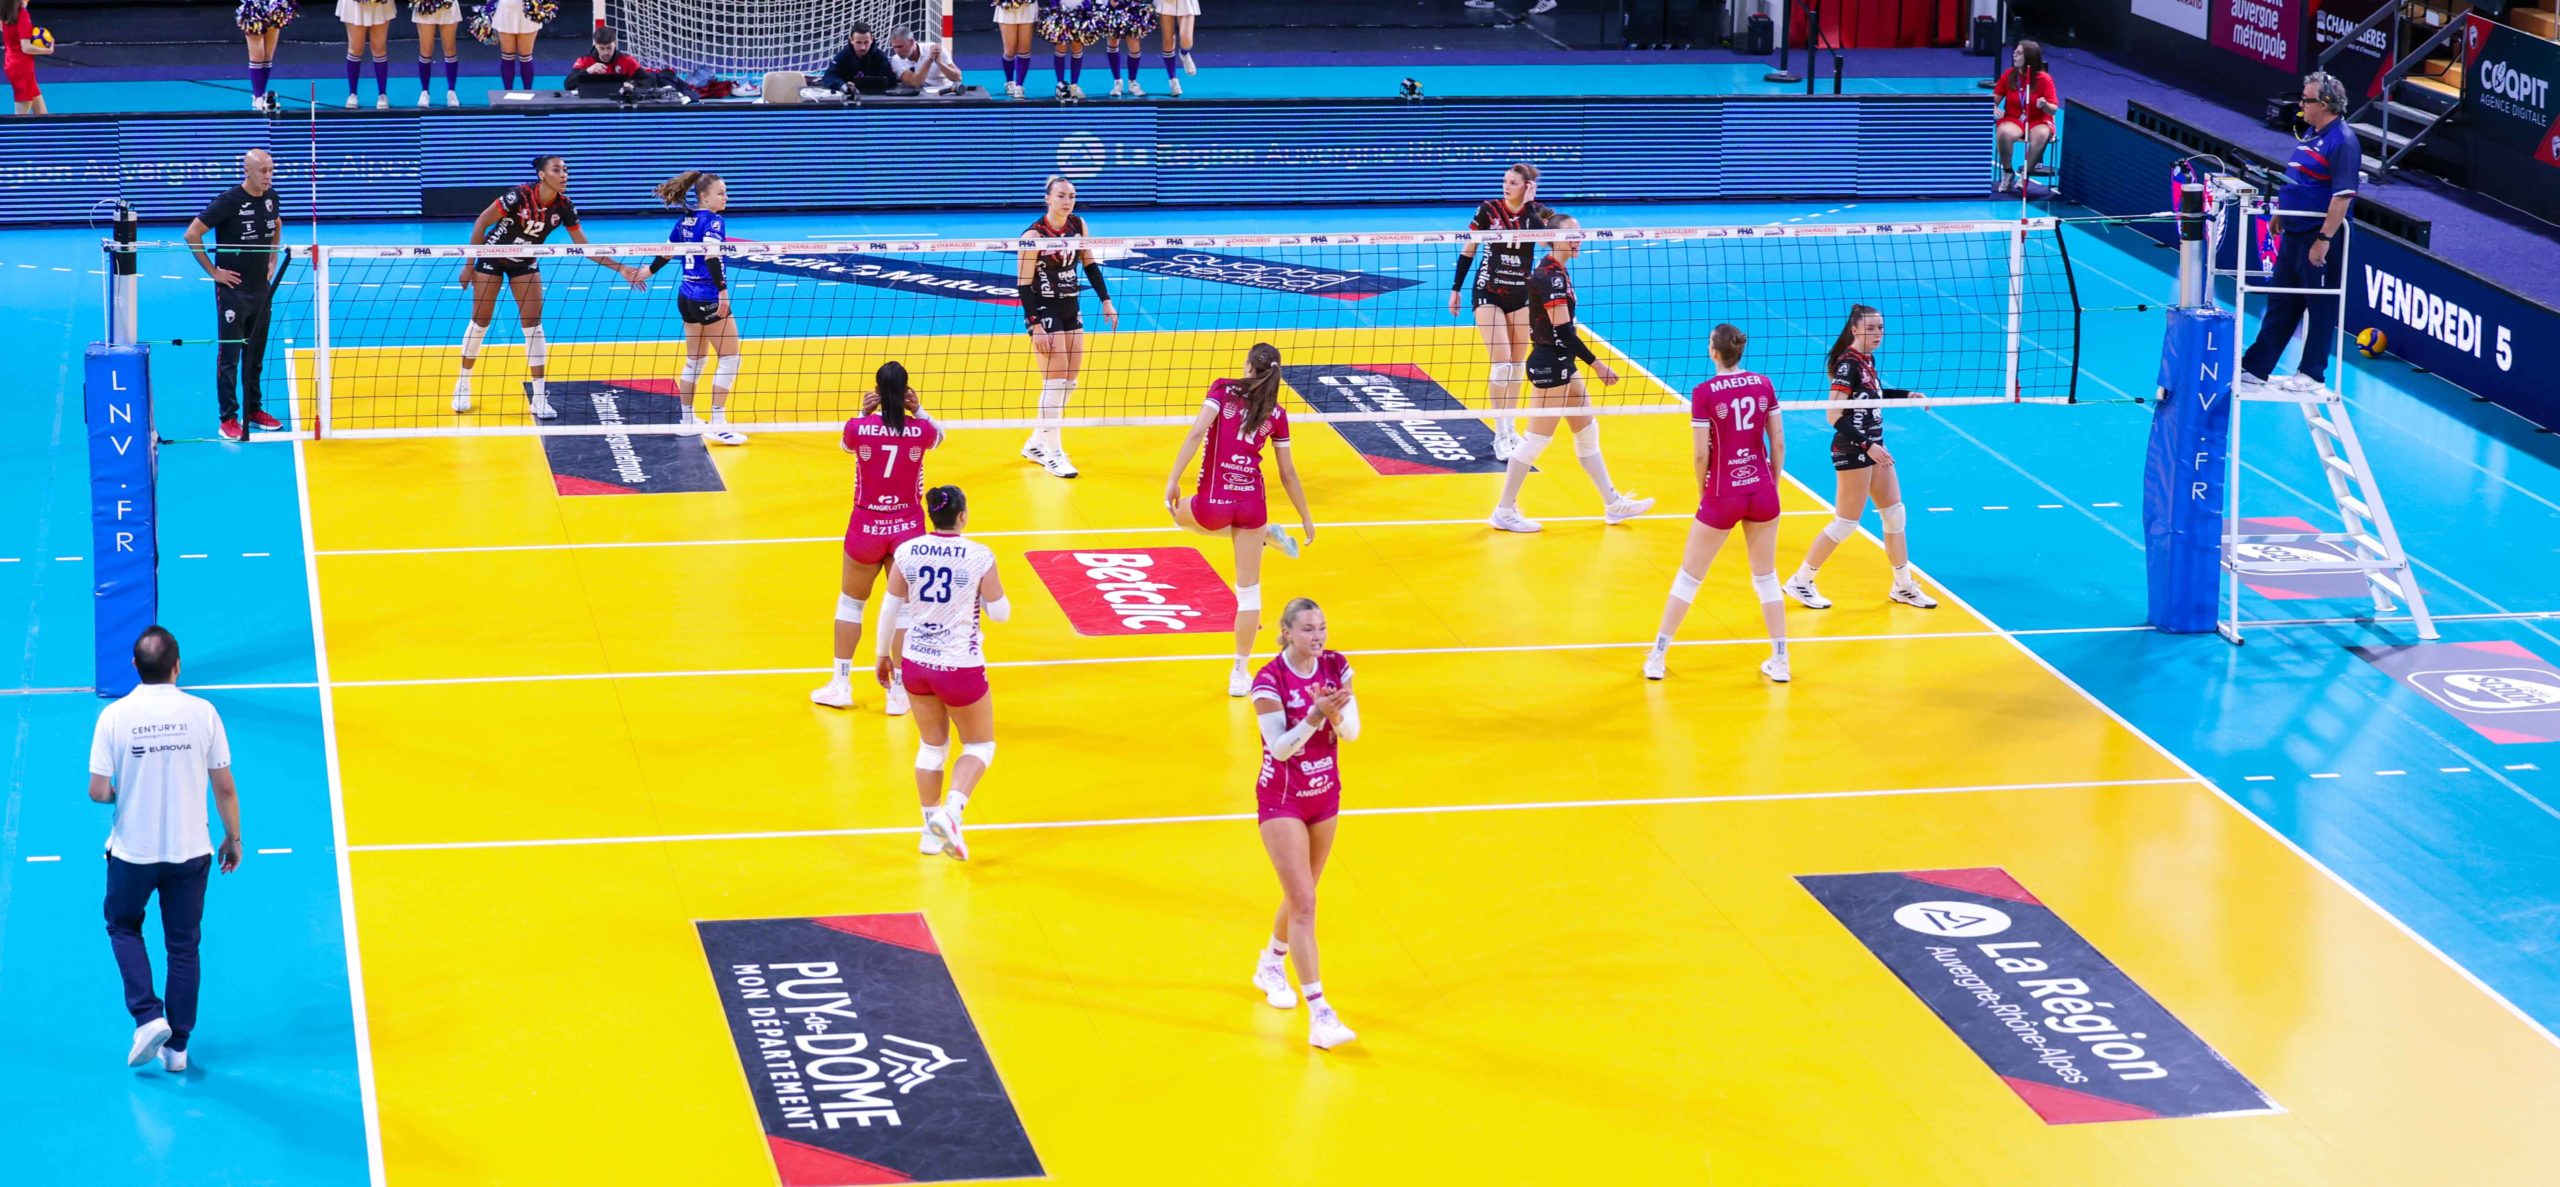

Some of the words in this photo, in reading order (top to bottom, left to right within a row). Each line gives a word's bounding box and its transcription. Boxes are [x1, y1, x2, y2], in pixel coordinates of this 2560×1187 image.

[2231, 0, 2279, 31] auvergne
[2233, 24, 2287, 60] métropole
[2481, 60, 2549, 109] COQPIT
[2480, 93, 2510, 113] AGENCE
[2512, 104, 2547, 127] DIGITALE
[523, 219, 545, 237] 12
[2365, 264, 2482, 358] VENDREDI
[2496, 325, 2512, 371] 5
[1710, 375, 1762, 392] MAEDER
[1731, 396, 1755, 431] 12
[881, 445, 898, 478] 7
[863, 520, 917, 535] BÉZIERS
[911, 544, 966, 558] ROMATI
[919, 565, 952, 604] 23
[1073, 552, 1202, 630] Betclic
[132, 723, 177, 735] CENTURY
[149, 744, 191, 752] EUROVIA
[732, 964, 770, 998] MON
[1925, 945, 2089, 1084] Auvergne-Rhône-Alpes
[1977, 941, 2048, 974] La
[2018, 977, 2169, 1081] Région
[747, 1006, 818, 1129] DÉPARTEMENT
